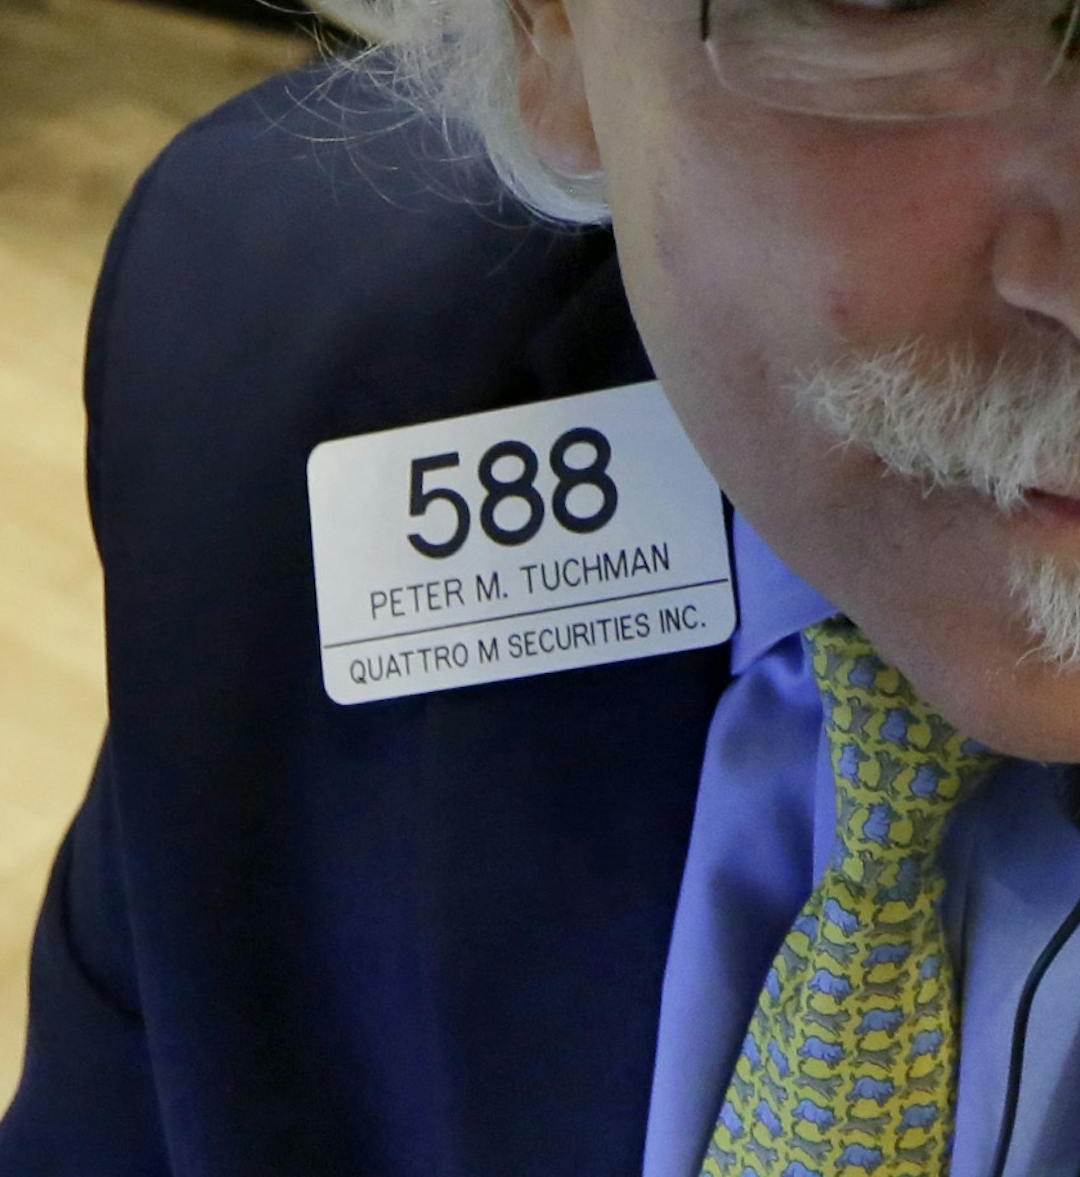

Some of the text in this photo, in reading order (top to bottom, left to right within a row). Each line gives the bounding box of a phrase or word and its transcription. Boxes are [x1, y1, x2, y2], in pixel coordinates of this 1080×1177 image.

[407, 426, 618, 559] 588
[370, 542, 671, 620] PETER M. TUCHMAN
[349, 604, 706, 685] QUATTRO M SECURITIES INC.
